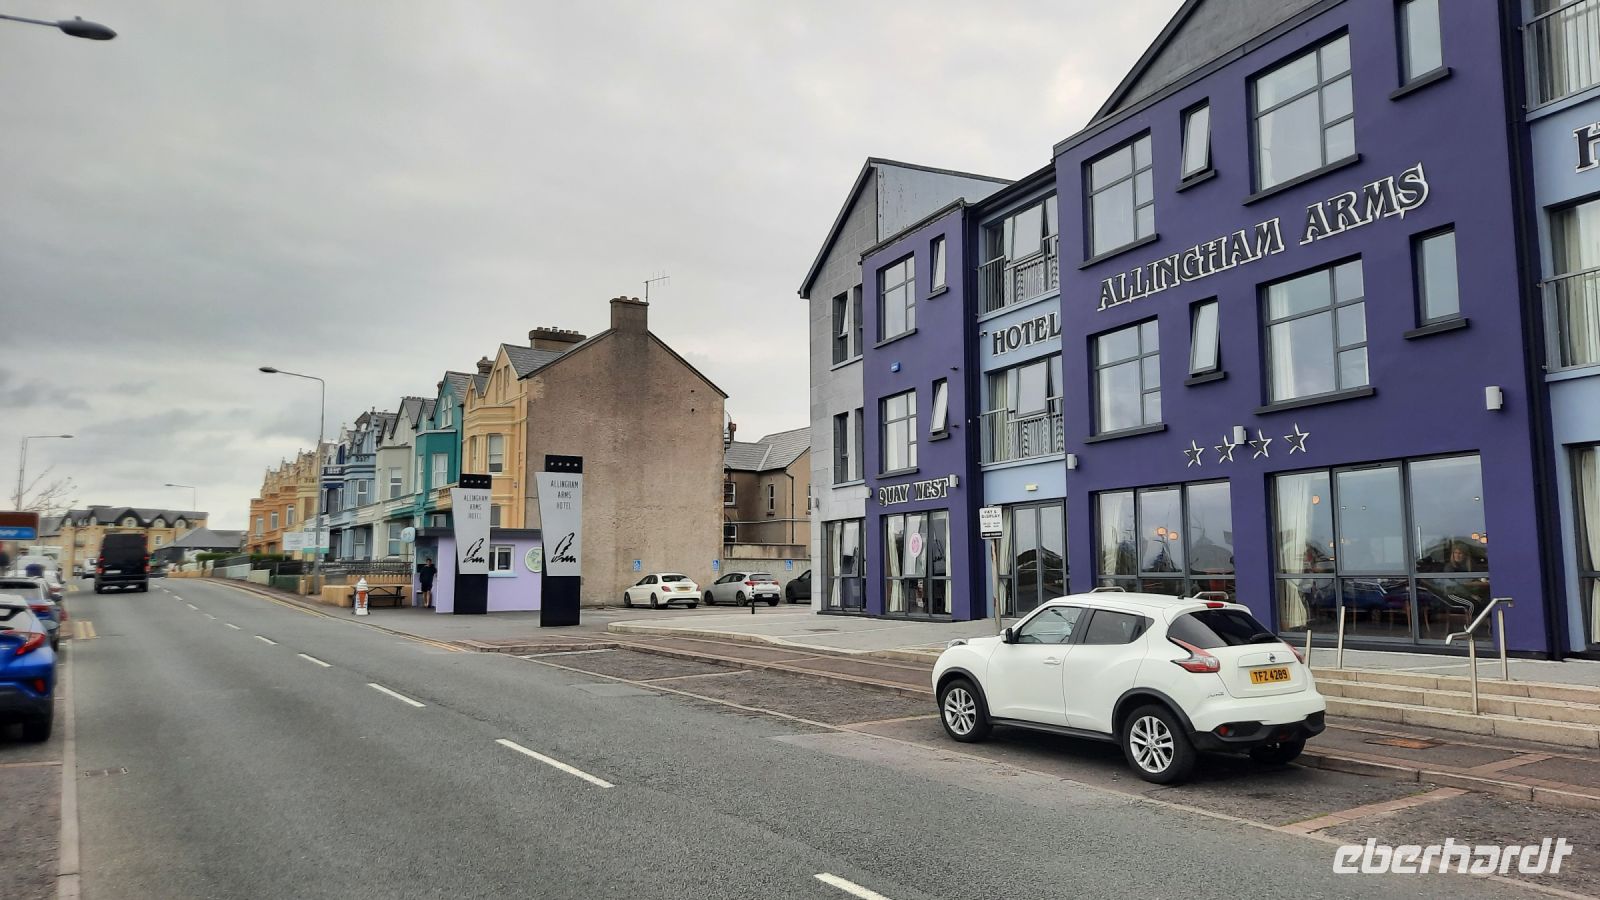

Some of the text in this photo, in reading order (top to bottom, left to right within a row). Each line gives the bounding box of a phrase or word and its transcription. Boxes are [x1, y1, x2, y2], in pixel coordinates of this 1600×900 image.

[1096, 161, 1430, 312] ALLINGHAM ARMS
[992, 312, 1061, 357] HOTEL
[550, 480, 579, 489] ALLINGHAM
[557, 491, 572, 499] ARMS
[878, 477, 949, 507] QUAY WEST
[556, 502, 571, 510] HOTEL
[1253, 670, 1269, 682] TFZ
